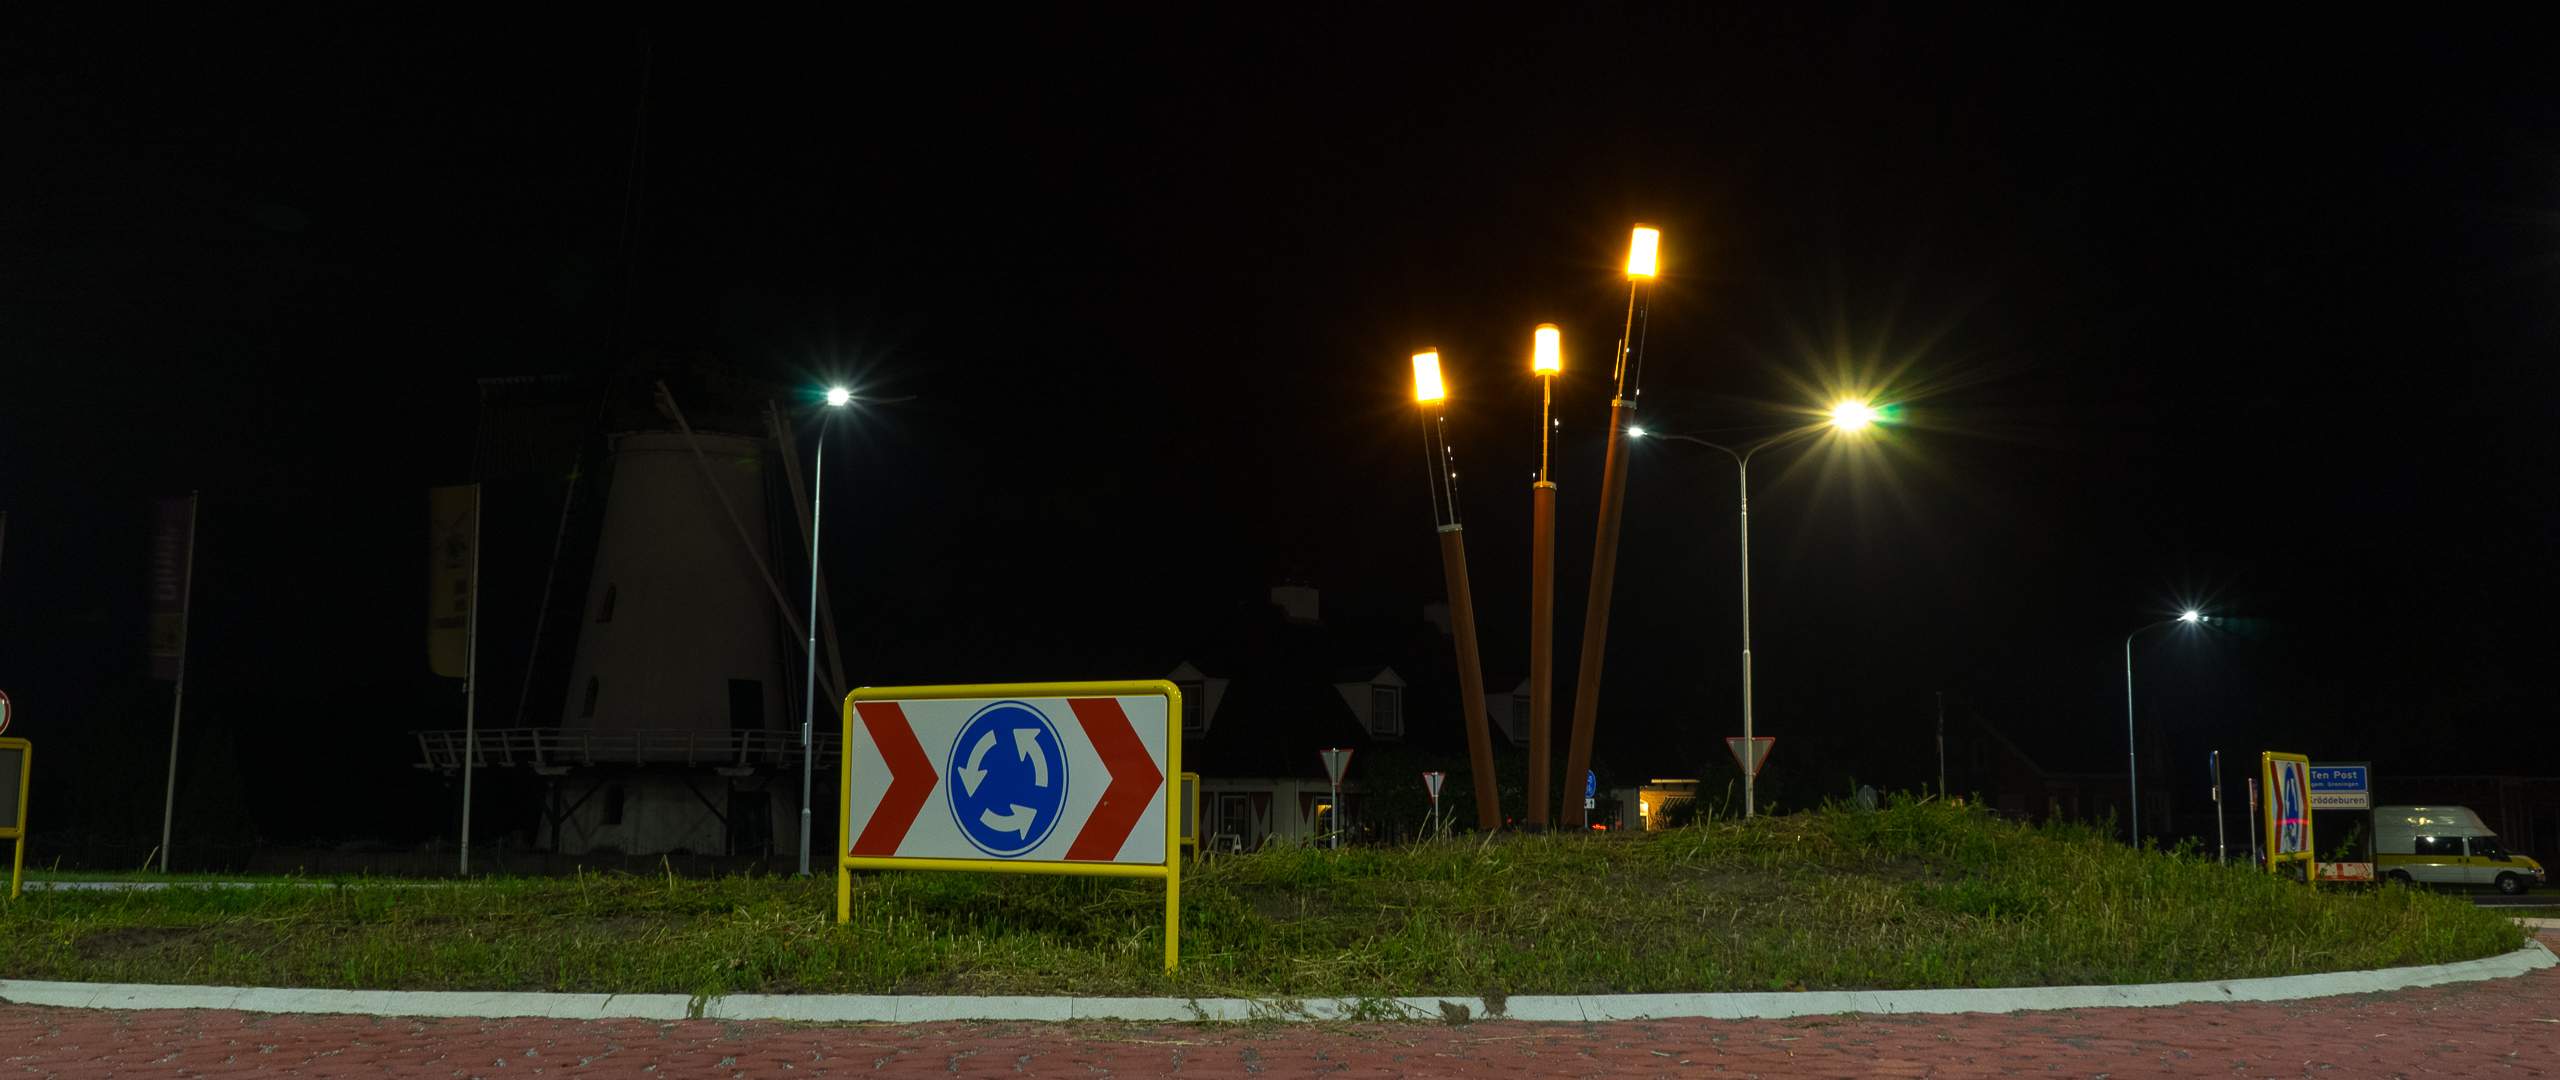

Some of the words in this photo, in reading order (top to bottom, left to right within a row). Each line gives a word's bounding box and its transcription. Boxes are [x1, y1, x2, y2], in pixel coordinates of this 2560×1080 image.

[2312, 771, 2329, 779] Ten
[2334, 771, 2357, 779] Post
[2311, 796, 2365, 804] röddeburen
